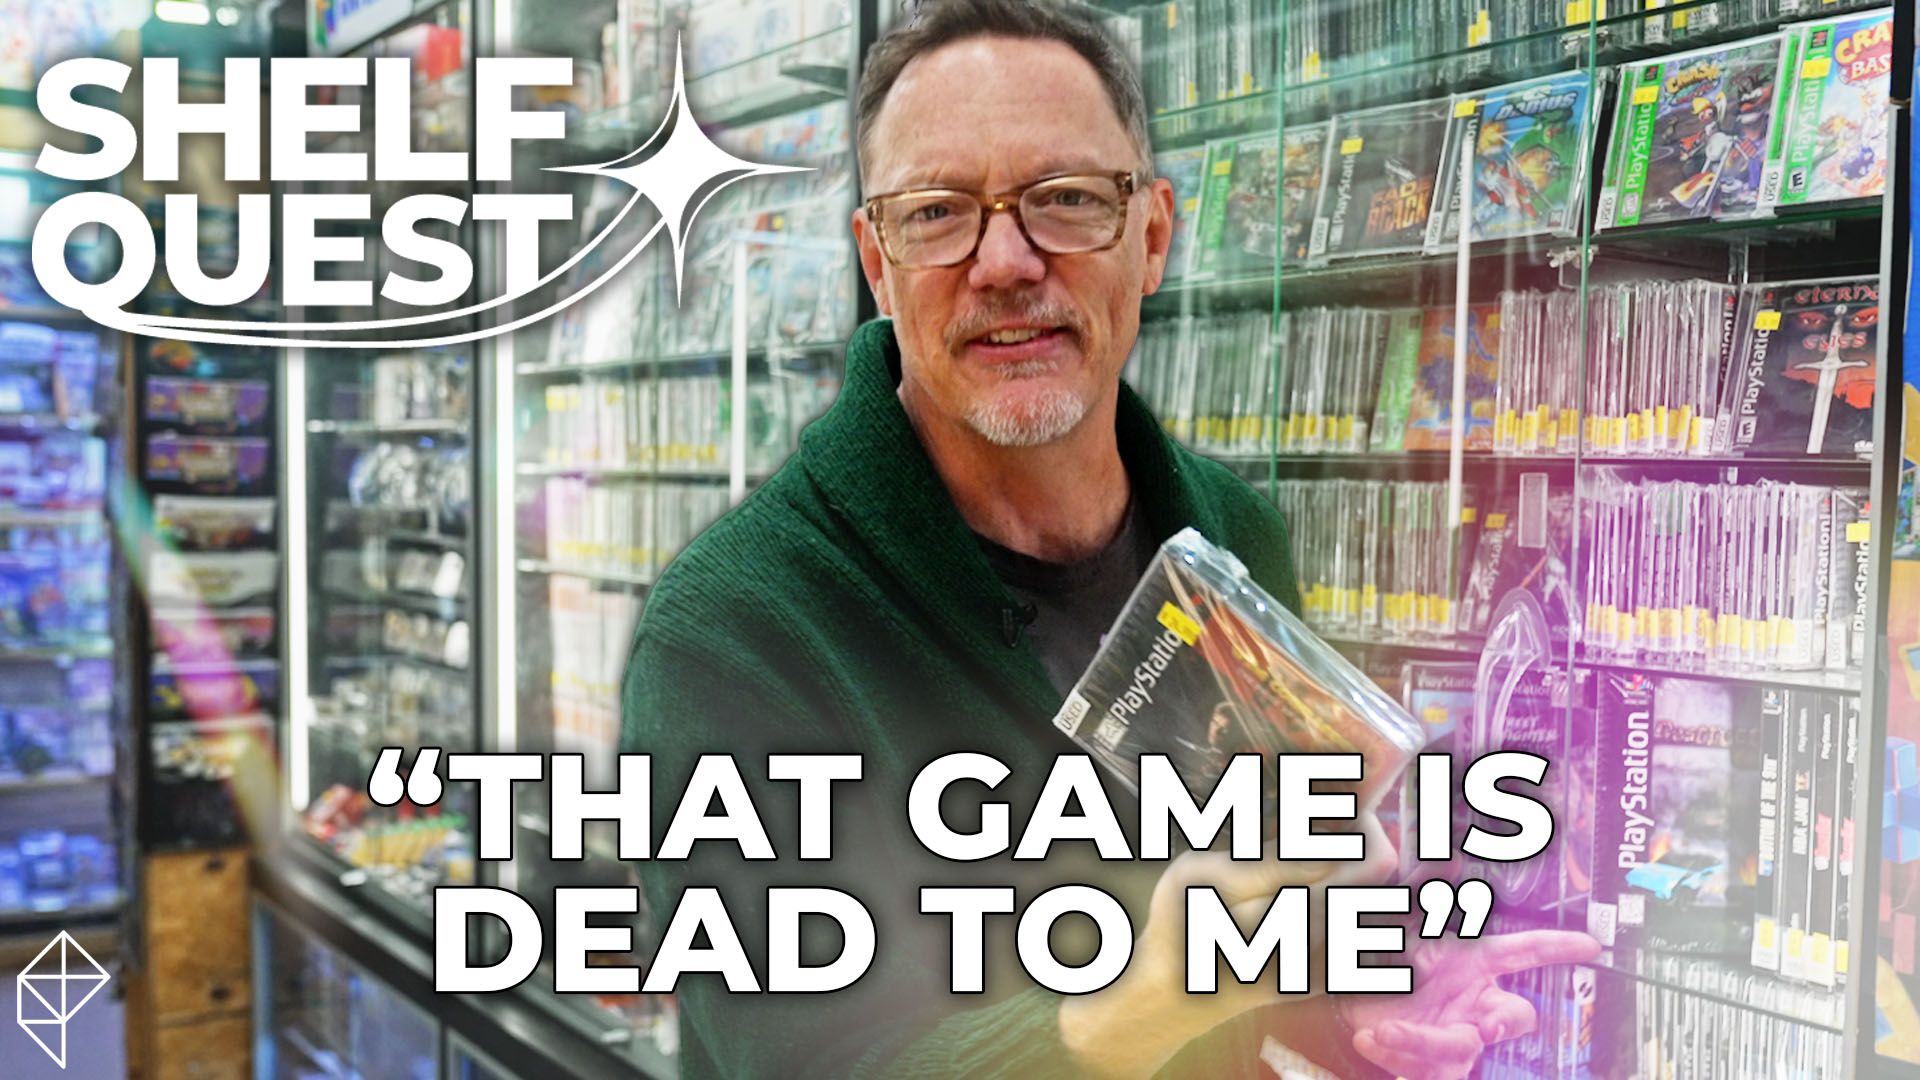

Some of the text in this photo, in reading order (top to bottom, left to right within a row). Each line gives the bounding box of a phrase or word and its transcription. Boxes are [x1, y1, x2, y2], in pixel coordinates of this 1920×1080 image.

[1626, 102, 1653, 189] PlayStatio
[1766, 171, 1779, 202] USED
[1791, 171, 1804, 187] E
[1741, 328, 1771, 414] PlayStatio
[1061, 701, 1084, 730] USED
[1109, 629, 1183, 725] PlayStatio
[1618, 711, 1654, 868] PlayStation
